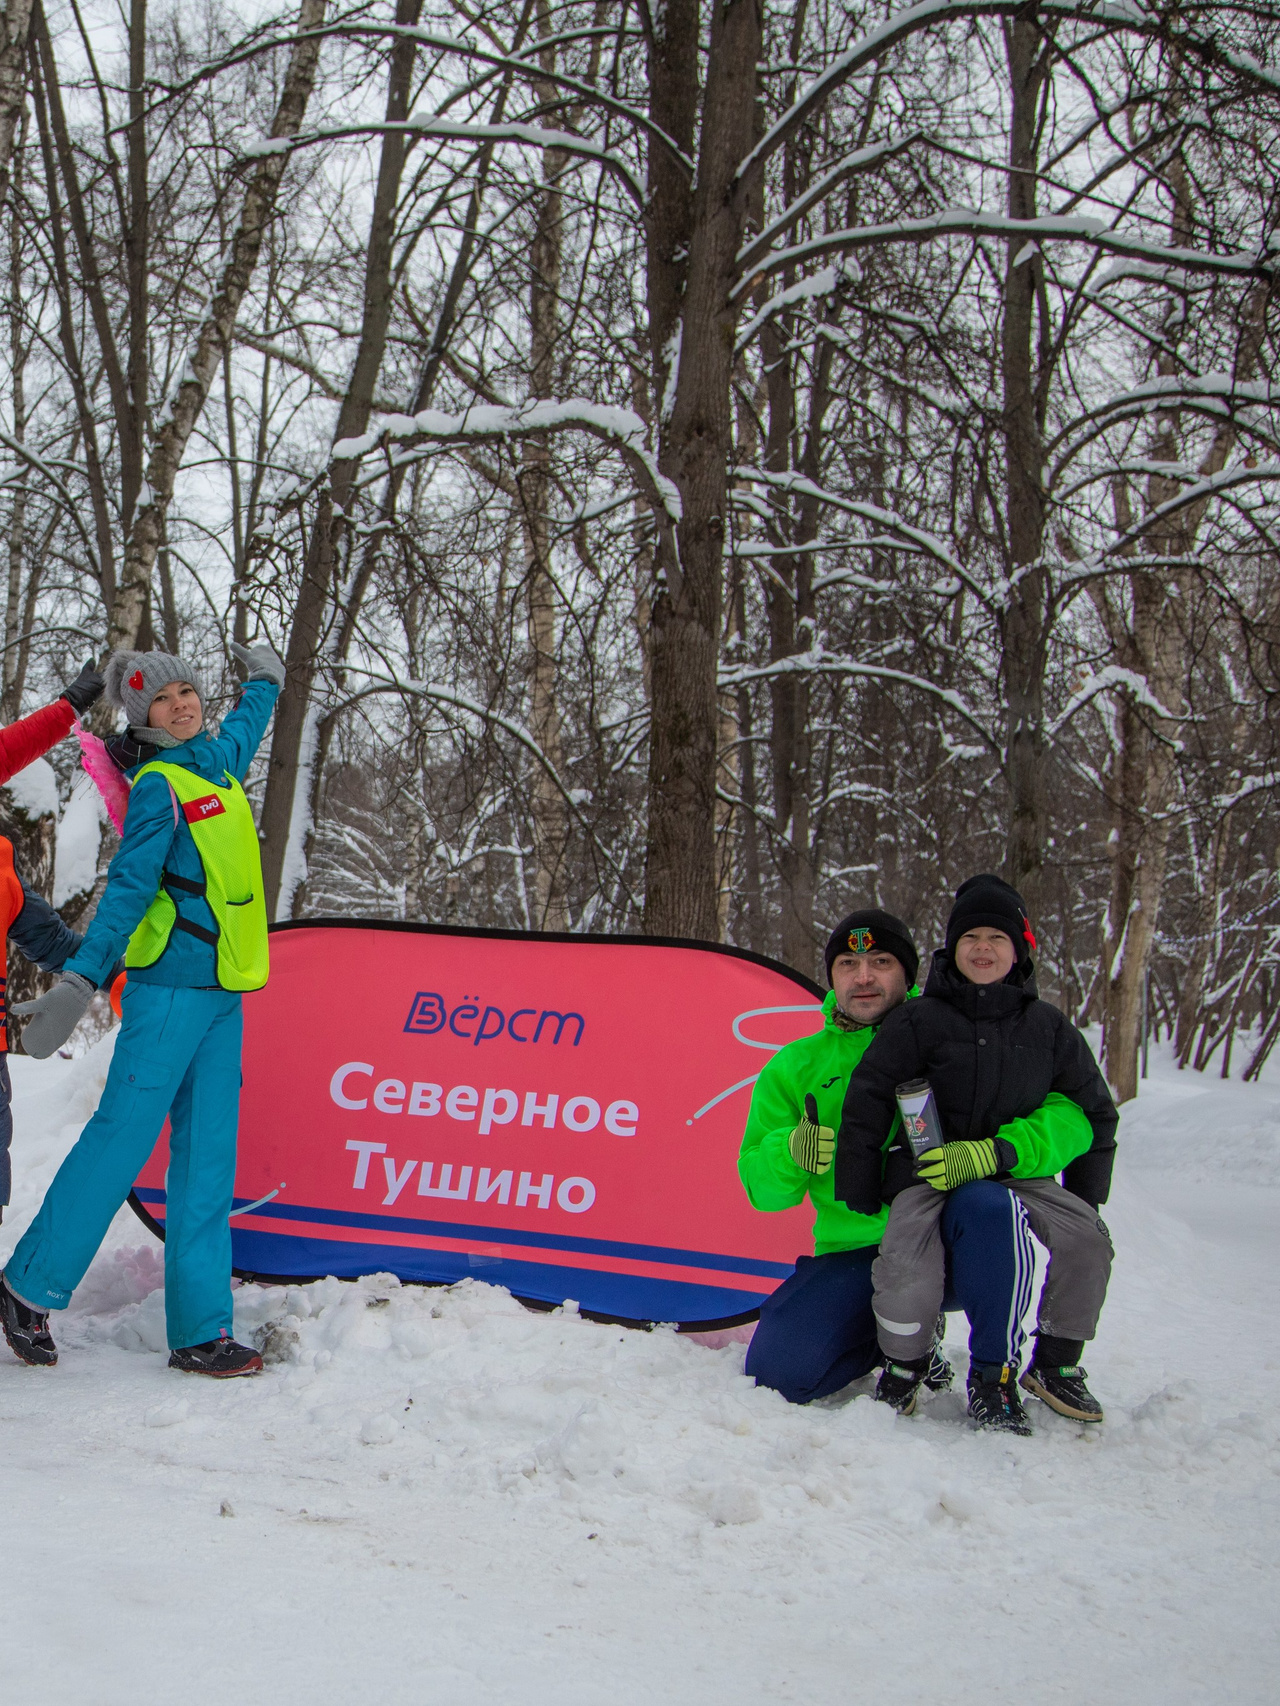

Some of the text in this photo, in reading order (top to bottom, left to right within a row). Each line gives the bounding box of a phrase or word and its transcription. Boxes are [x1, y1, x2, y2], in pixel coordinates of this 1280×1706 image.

[329, 1061, 640, 1138] Северное
[345, 1139, 597, 1214] Тушино
[46, 1290, 65, 1300] ROXY
